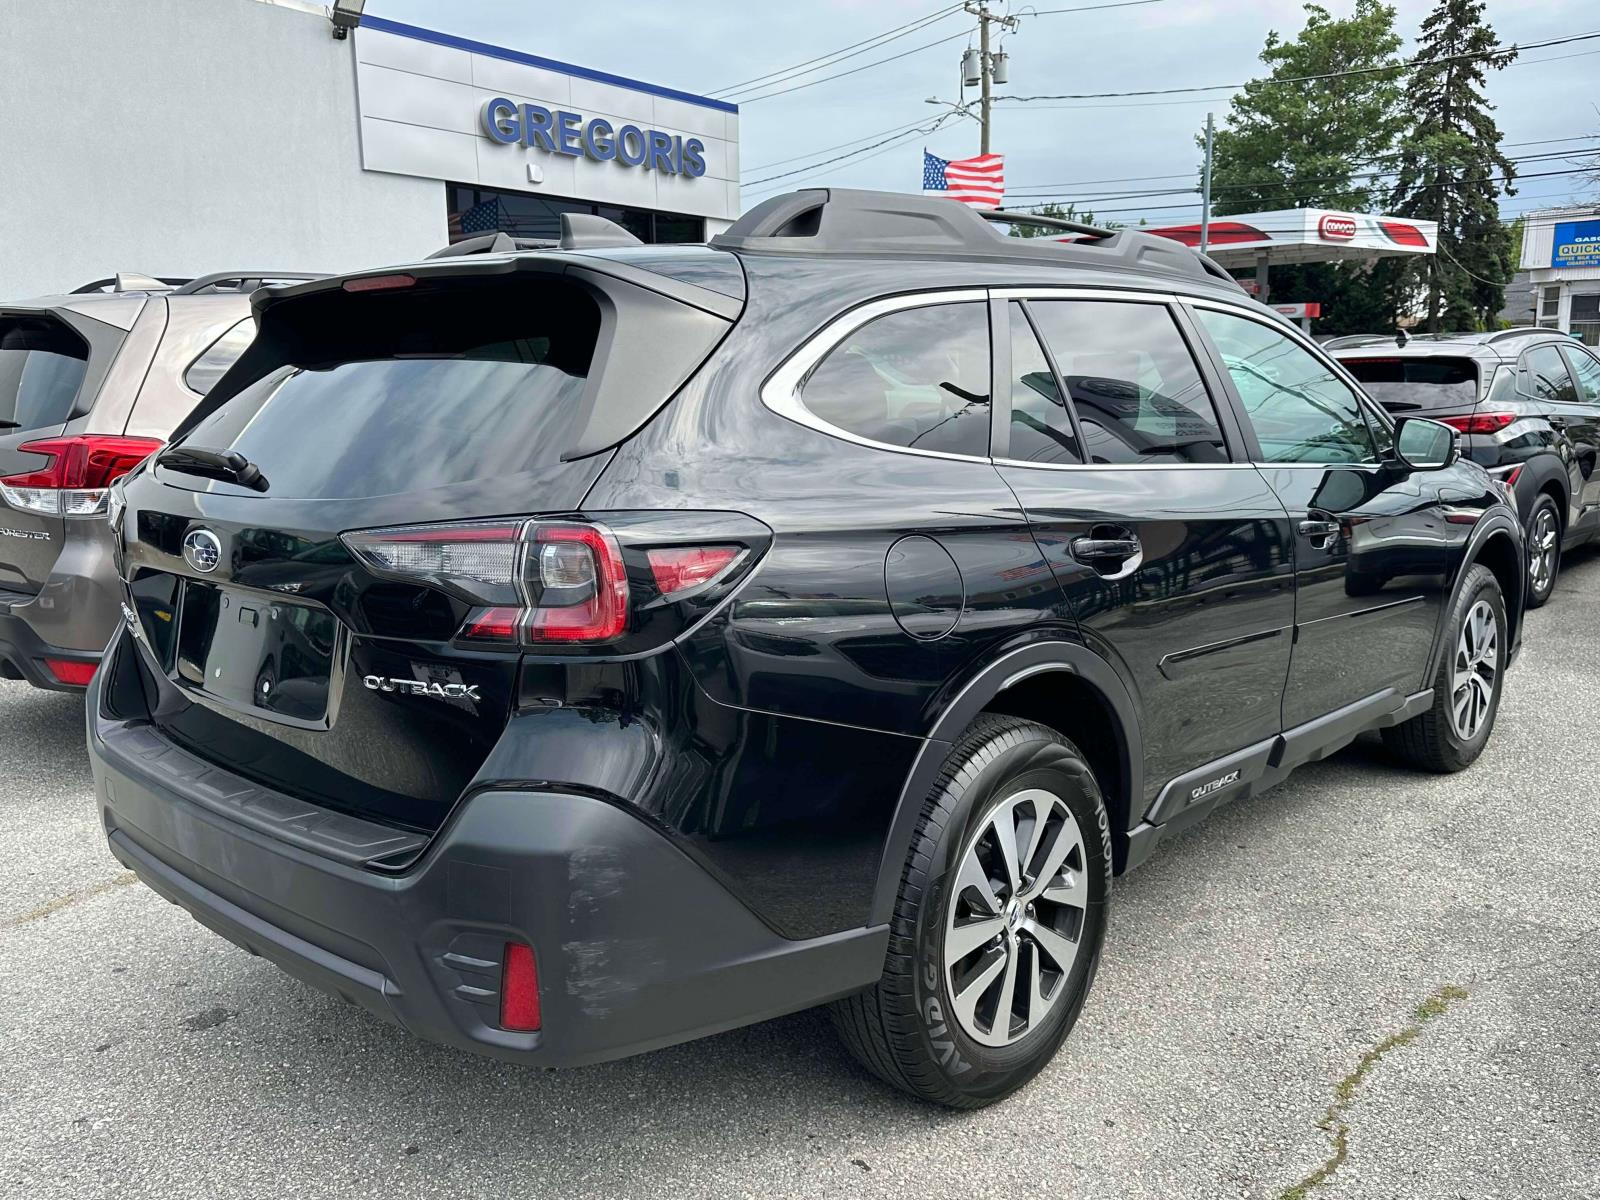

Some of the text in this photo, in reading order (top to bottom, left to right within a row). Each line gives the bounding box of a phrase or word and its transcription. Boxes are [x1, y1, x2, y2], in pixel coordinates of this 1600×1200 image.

[482, 97, 706, 177] GREGORIS
[1561, 244, 1600, 255] QUICK
[363, 674, 481, 700] OUTBACK
[1191, 770, 1239, 799] OUTBACK
